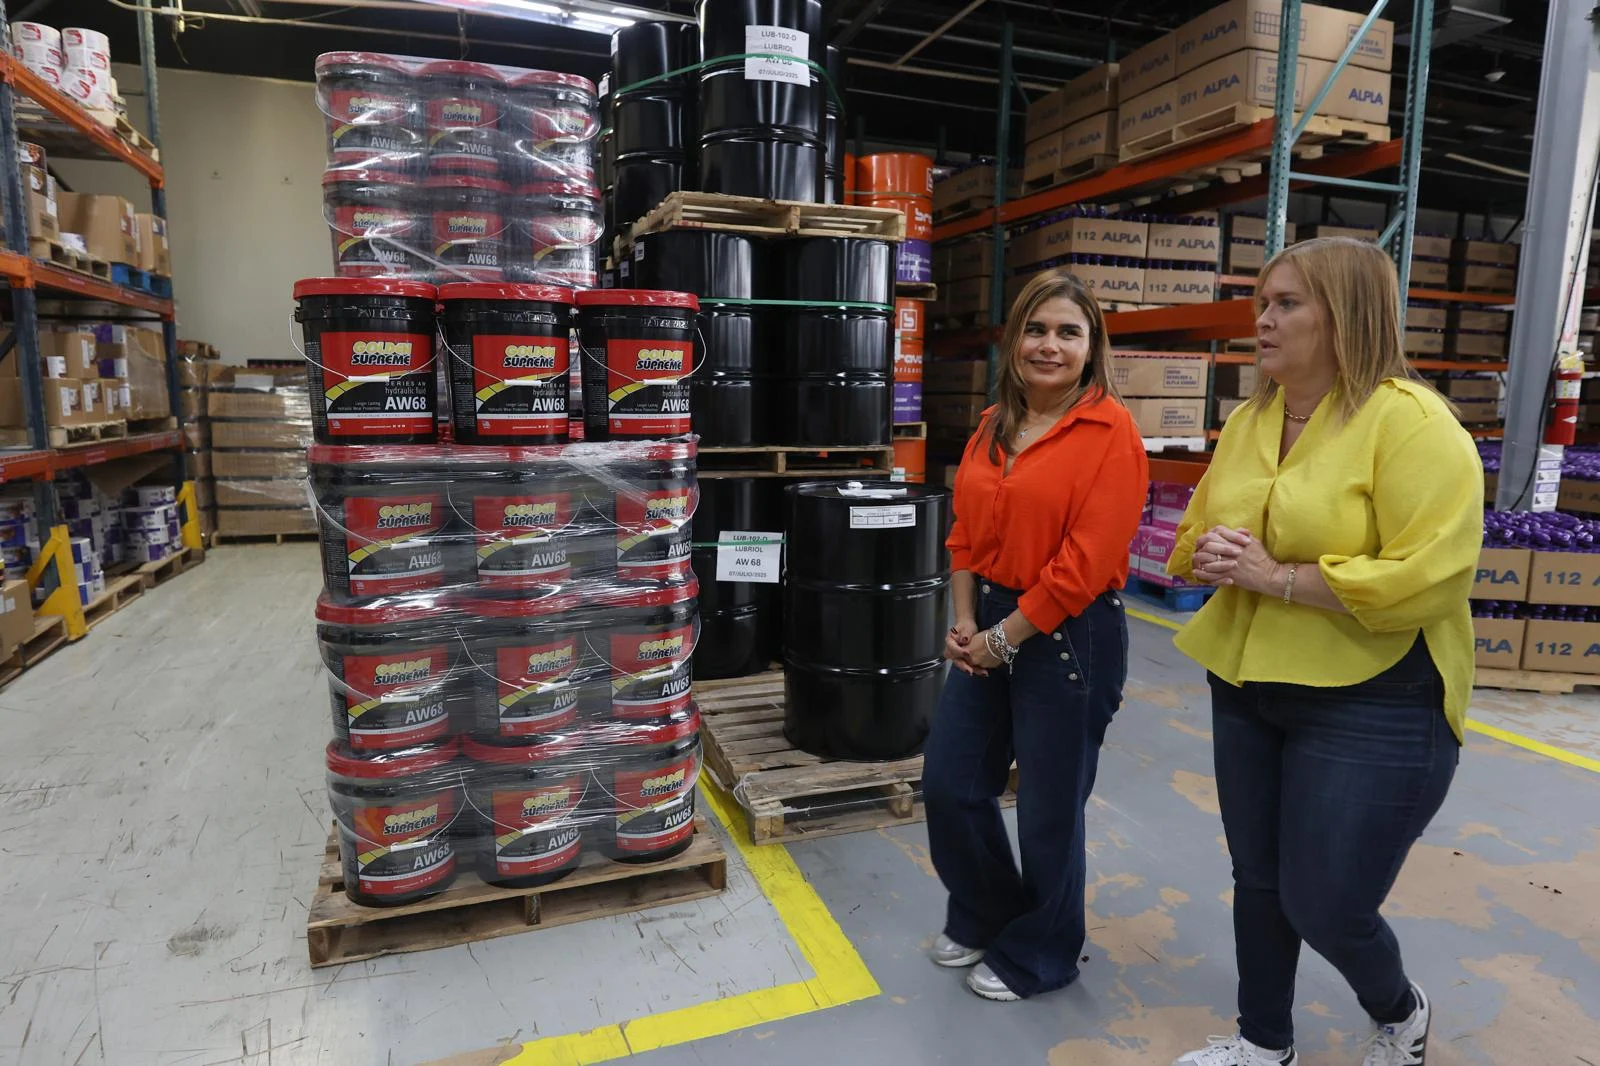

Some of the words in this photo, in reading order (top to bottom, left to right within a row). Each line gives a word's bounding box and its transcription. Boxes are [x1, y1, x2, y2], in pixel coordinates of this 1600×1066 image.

[761, 30, 797, 41] LUB-102-D
[1201, 20, 1238, 43] ALPLA
[764, 43, 793, 53] LUBRIOL
[1203, 73, 1240, 96] ALPLA
[1348, 88, 1383, 105] ALPLA
[1140, 103, 1172, 121] ALPLA
[462, 143, 493, 156] AW68
[1076, 231, 1096, 241] 112
[1101, 231, 1142, 244] ALPLA
[1154, 238, 1172, 248] 112
[1177, 238, 1216, 250] ALPLA
[467, 253, 498, 266] AW68
[1101, 279, 1141, 292] ALPLA
[1149, 283, 1168, 293] 112
[1172, 283, 1211, 294] ALPLA
[351, 353, 411, 366] SUPREME
[503, 356, 555, 368] SUPREME
[636, 360, 683, 371] SUPREME
[385, 386, 413, 396] hydraulic
[385, 396, 427, 410] AW68
[532, 398, 565, 412] AW68
[661, 399, 690, 412] AW68
[377, 513, 430, 529] SUPREME
[503, 513, 555, 526] SUPREME
[408, 551, 442, 570] AW68
[531, 550, 567, 567] AW68
[736, 558, 749, 566] AW
[750, 558, 762, 567] 68
[1474, 568, 1520, 586] PLA
[1544, 571, 1581, 586] 112
[637, 646, 682, 661] SUPREME
[1474, 638, 1513, 654] PLA
[1535, 642, 1573, 656] 112
[528, 655, 573, 674] SUPREME
[374, 669, 430, 686] SUPREME
[661, 678, 690, 697] AW68
[405, 701, 444, 725] AW68
[640, 779, 684, 798] SUPREME
[521, 799, 569, 818] SUPREME
[383, 813, 438, 836] SUPREME
[664, 809, 693, 829] AW68
[413, 843, 450, 870] AW68
